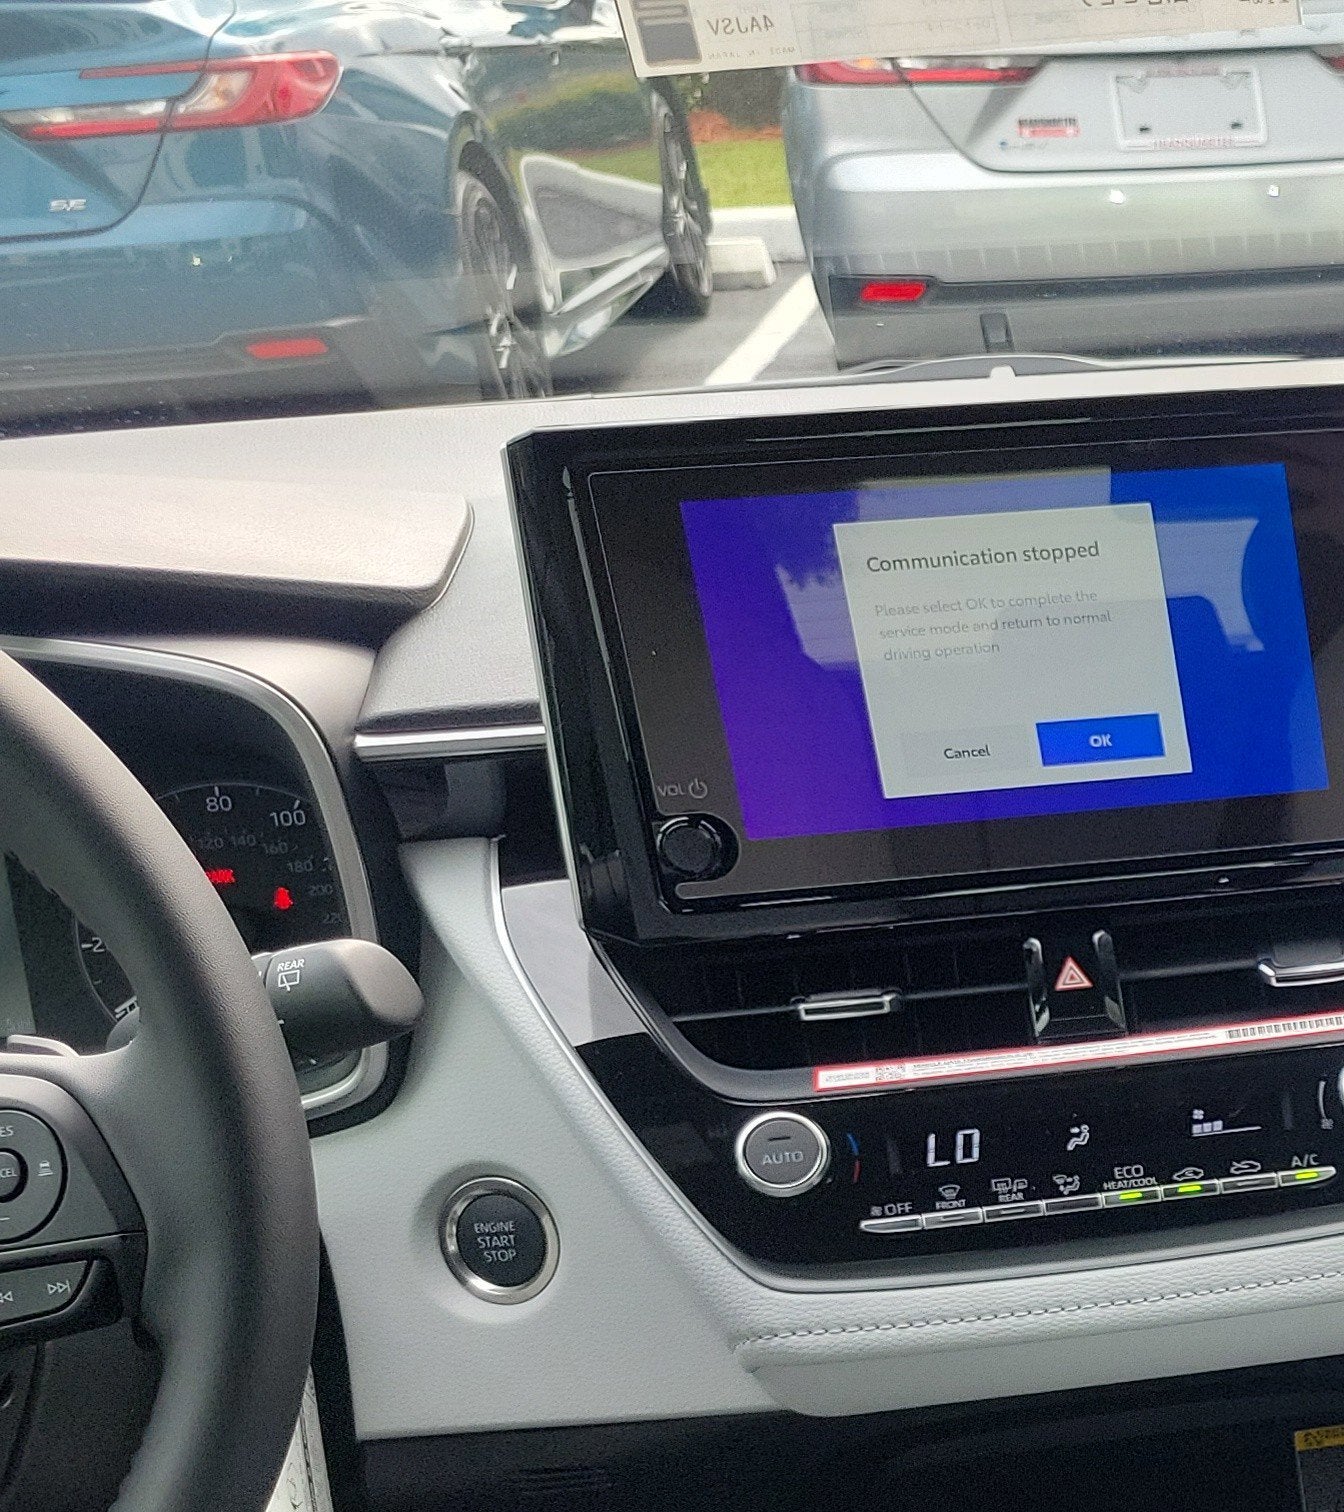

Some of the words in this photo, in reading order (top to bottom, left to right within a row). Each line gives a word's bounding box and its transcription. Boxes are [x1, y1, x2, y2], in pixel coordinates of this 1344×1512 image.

[867, 547, 1017, 573] Communication
[1022, 541, 1100, 563] stopped
[874, 603, 920, 617] Please
[923, 600, 962, 614] select
[966, 597, 988, 611] OK
[991, 595, 1006, 609] to
[1008, 592, 1073, 611] complete
[1075, 590, 1098, 603] the
[879, 625, 926, 640] service
[930, 621, 969, 636] mode
[973, 618, 999, 633] and
[1002, 617, 1043, 631] return
[1047, 615, 1061, 627] to
[1063, 610, 1112, 625] normal
[883, 646, 931, 663] driving
[1088, 733, 1113, 748] OK
[943, 744, 991, 760] Cancel
[656, 782, 685, 797] VOL
[206, 795, 232, 812] 80
[269, 810, 306, 827] 100
[277, 959, 305, 972] REAR
[927, 1128, 980, 1167] LO
[761, 1151, 804, 1166] AUTO
[1291, 1154, 1319, 1168] A/C
[1113, 1164, 1143, 1180] ECO
[1103, 1177, 1158, 1190] HEAT/COOL
[998, 1192, 1024, 1201] REAR
[884, 1202, 912, 1215] OFF
[936, 1200, 966, 1210] FRONT
[474, 1220, 515, 1233] ENGINE
[477, 1234, 515, 1249] START
[483, 1248, 517, 1263] STOP
